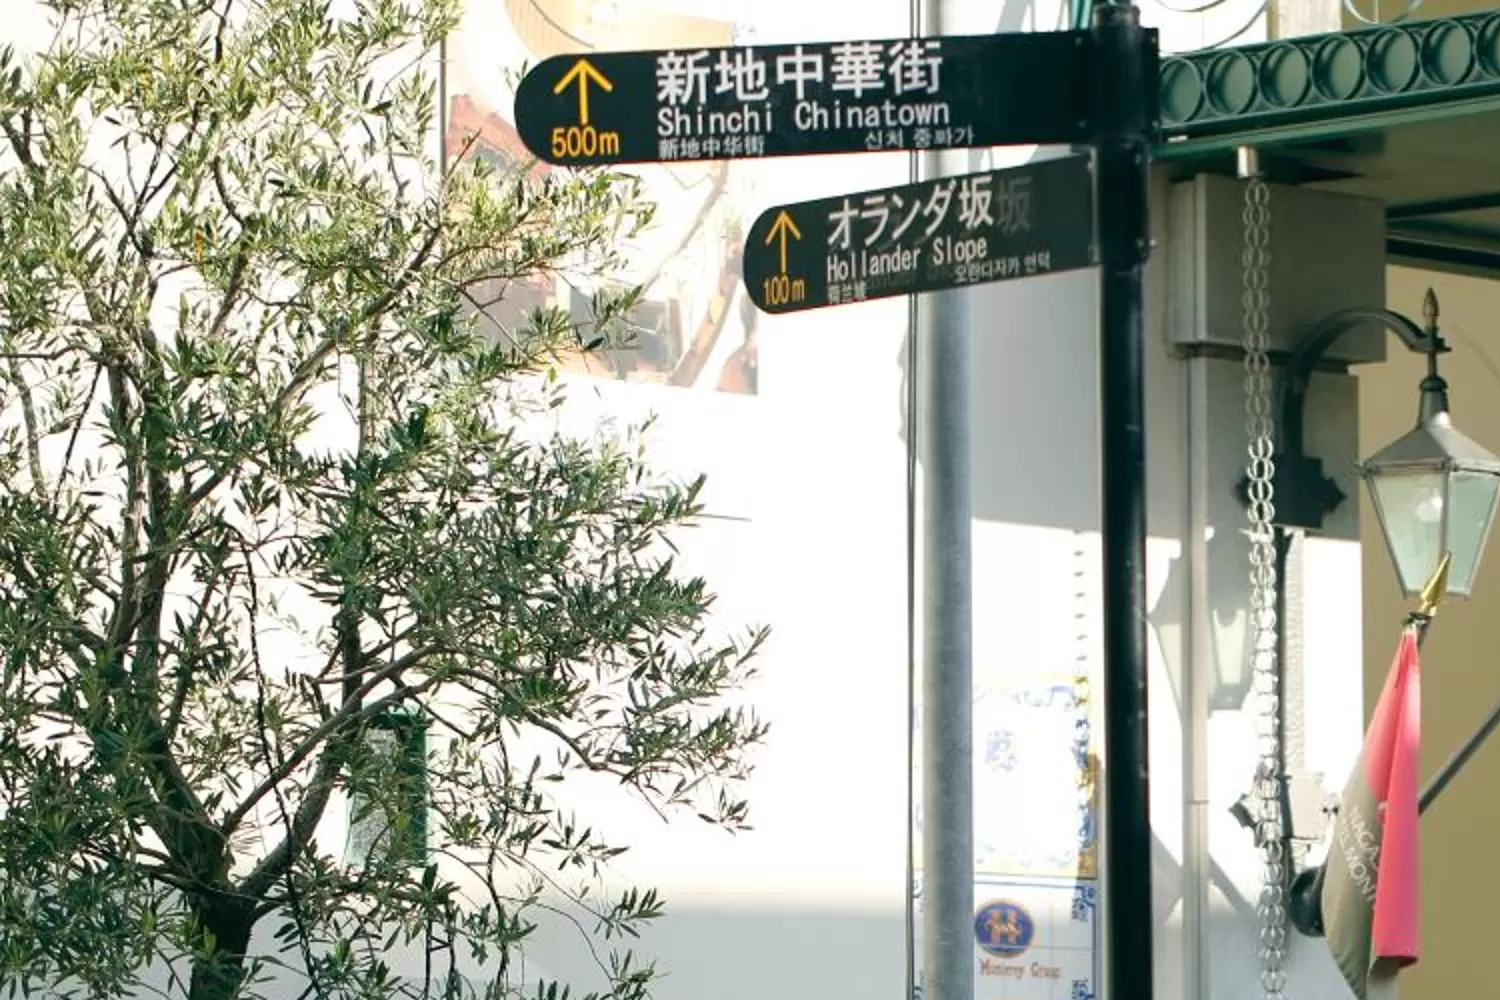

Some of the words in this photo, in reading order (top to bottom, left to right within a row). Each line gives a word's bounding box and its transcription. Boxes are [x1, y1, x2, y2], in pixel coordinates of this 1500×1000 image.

[656, 41, 943, 106] 新地中華街
[657, 103, 774, 138] Shinchi
[795, 99, 950, 131] Chinatown
[551, 127, 619, 159] 500m
[827, 175, 993, 250] オランダ坂
[827, 243, 921, 283] Hollander
[933, 235, 988, 270] Slope
[763, 276, 805, 306] 100m
